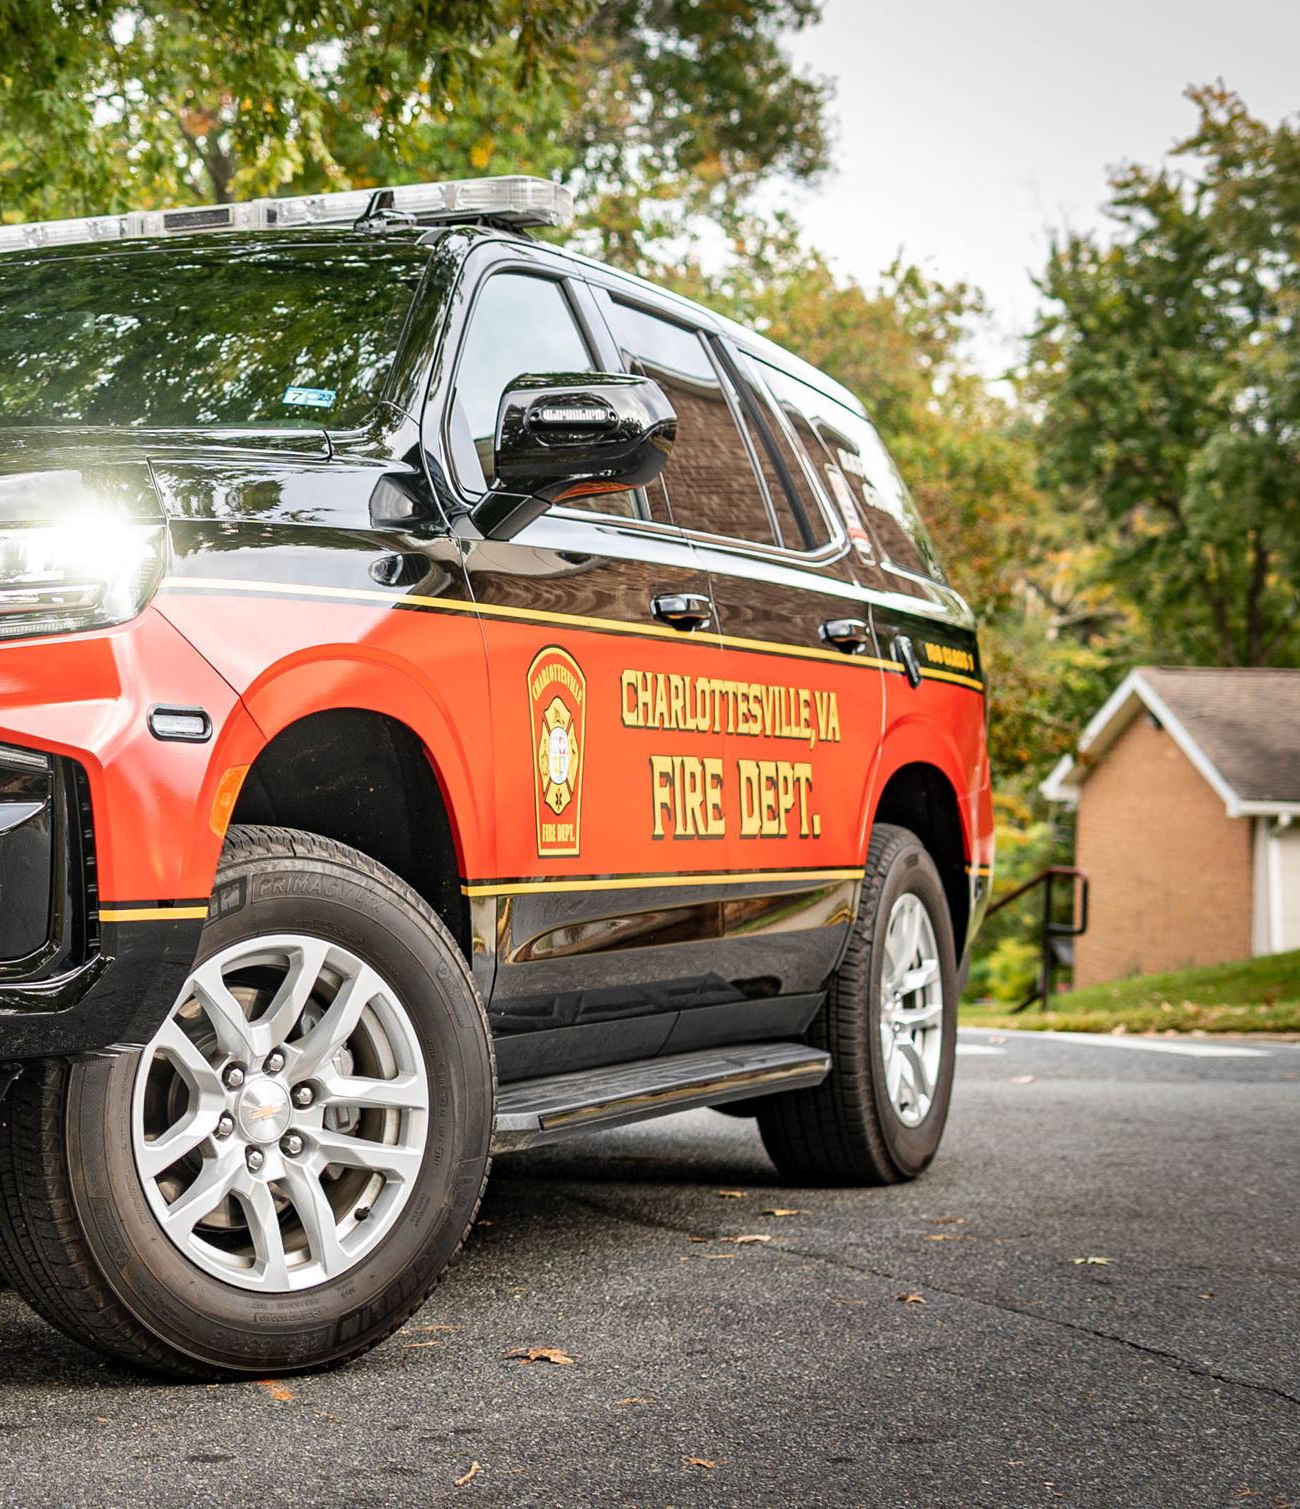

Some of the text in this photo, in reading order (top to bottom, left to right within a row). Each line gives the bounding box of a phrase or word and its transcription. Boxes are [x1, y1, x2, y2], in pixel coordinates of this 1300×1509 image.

[532, 663, 582, 706] CHARLOTTESVILLE
[650, 755, 821, 839] FIRE DEPT.
[542, 823, 556, 842] FIRE
[259, 873, 350, 899] PRIMACY
